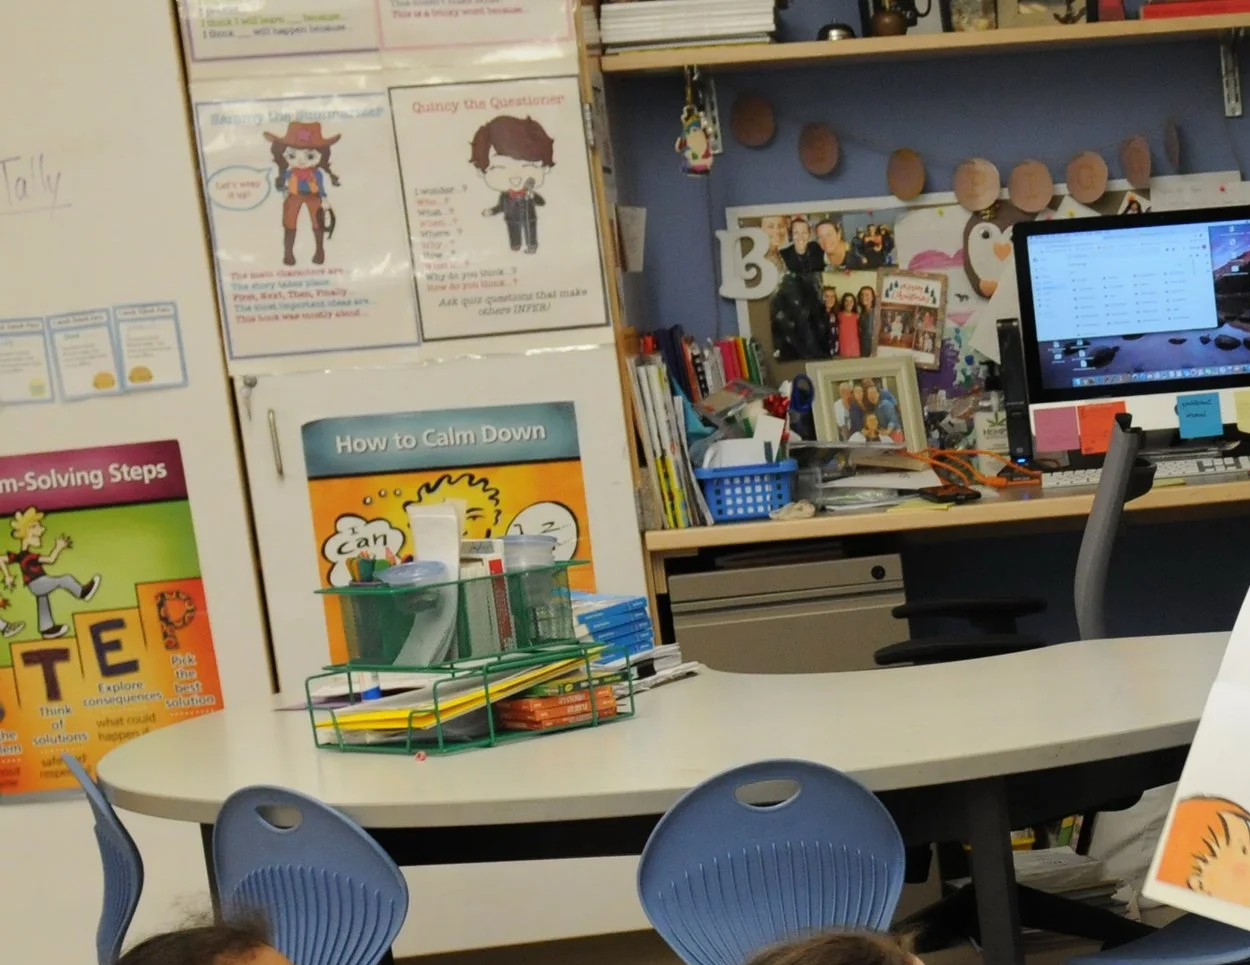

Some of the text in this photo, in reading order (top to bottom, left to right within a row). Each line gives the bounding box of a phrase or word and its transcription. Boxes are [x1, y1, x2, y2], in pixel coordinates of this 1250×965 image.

[412, 94, 565, 114] Quincy the Questioner
[335, 423, 546, 455] How to Calm Down
[108, 462, 168, 484] Steps
[336, 532, 388, 555] can
[155, 588, 196, 650] P
[89, 618, 139, 677] E
[21, 647, 70, 702] T
[175, 669, 195, 679] the
[98, 680, 144, 693] Explore
[83, 691, 162, 707] consequences
[165, 696, 214, 709] solution
[40, 704, 72, 716] Think
[51, 719, 64, 730] of
[32, 731, 88, 745] solutions
